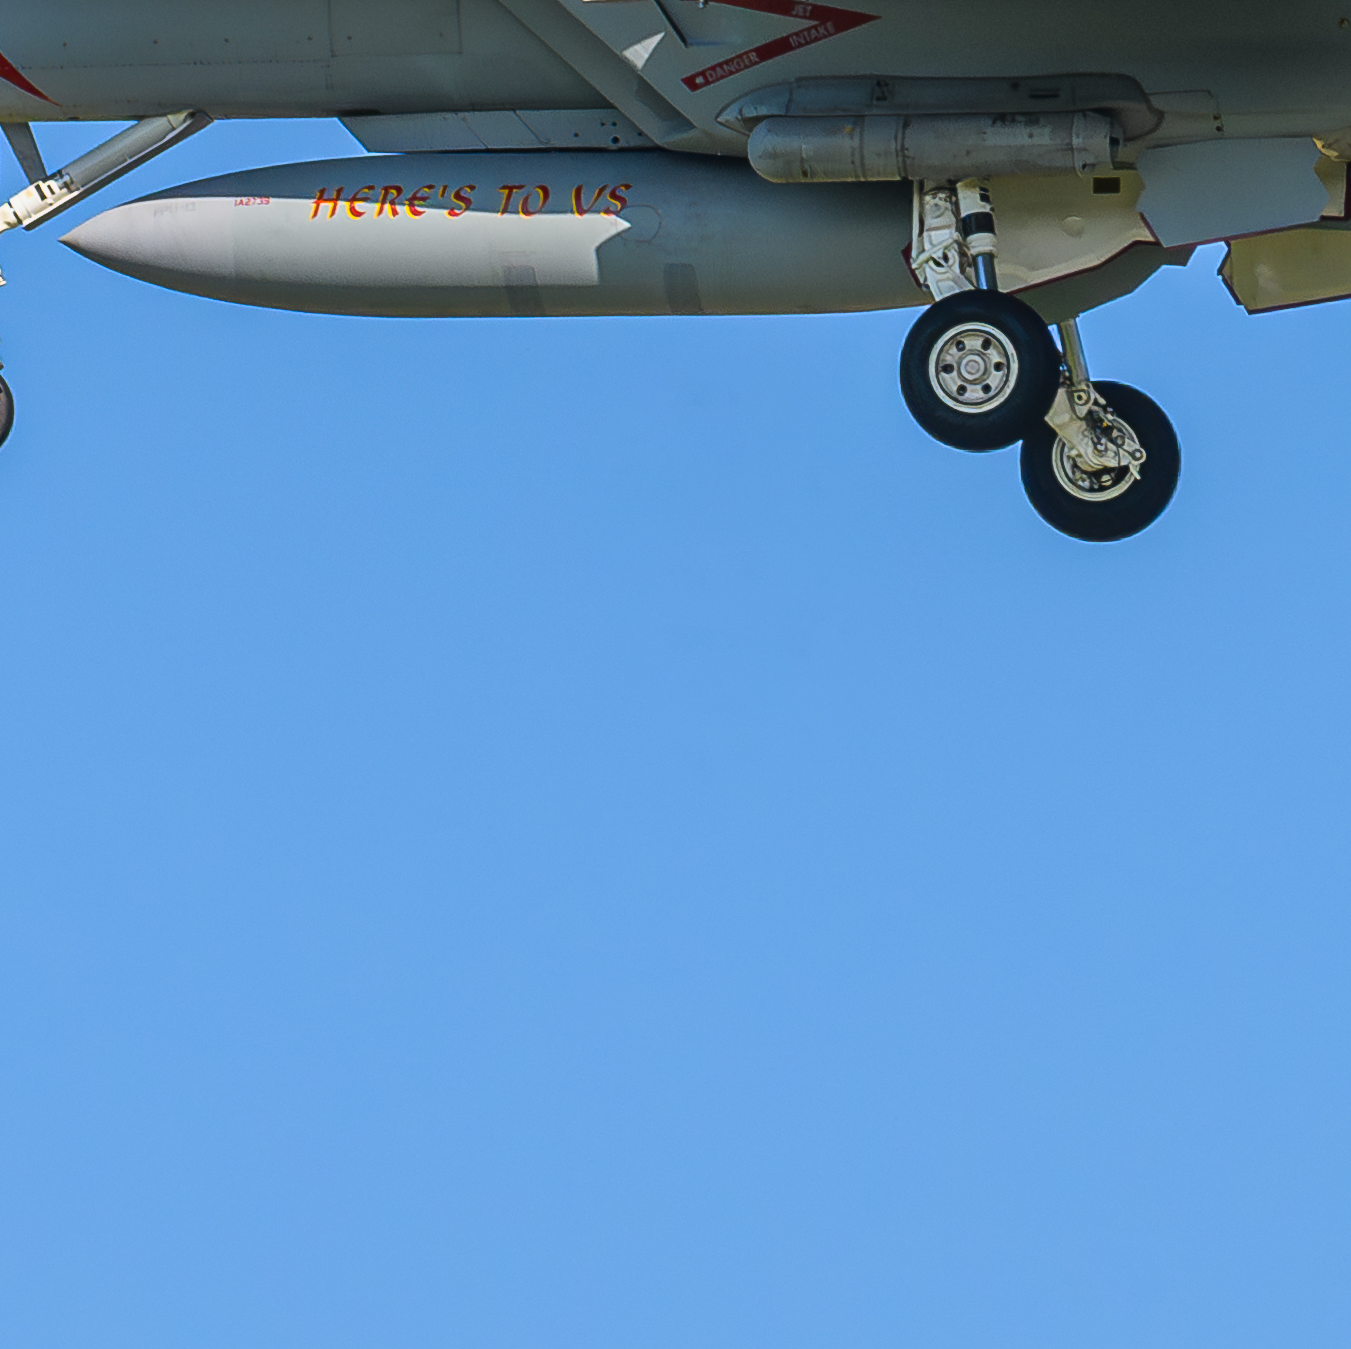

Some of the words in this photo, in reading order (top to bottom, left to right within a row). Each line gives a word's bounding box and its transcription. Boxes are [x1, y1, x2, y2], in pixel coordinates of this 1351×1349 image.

[791, 4, 812, 17] JET
[705, 52, 760, 82] DANGER
[789, 21, 835, 48] INTAKE
[309, 184, 477, 220] HERE'S
[497, 184, 550, 219] TO
